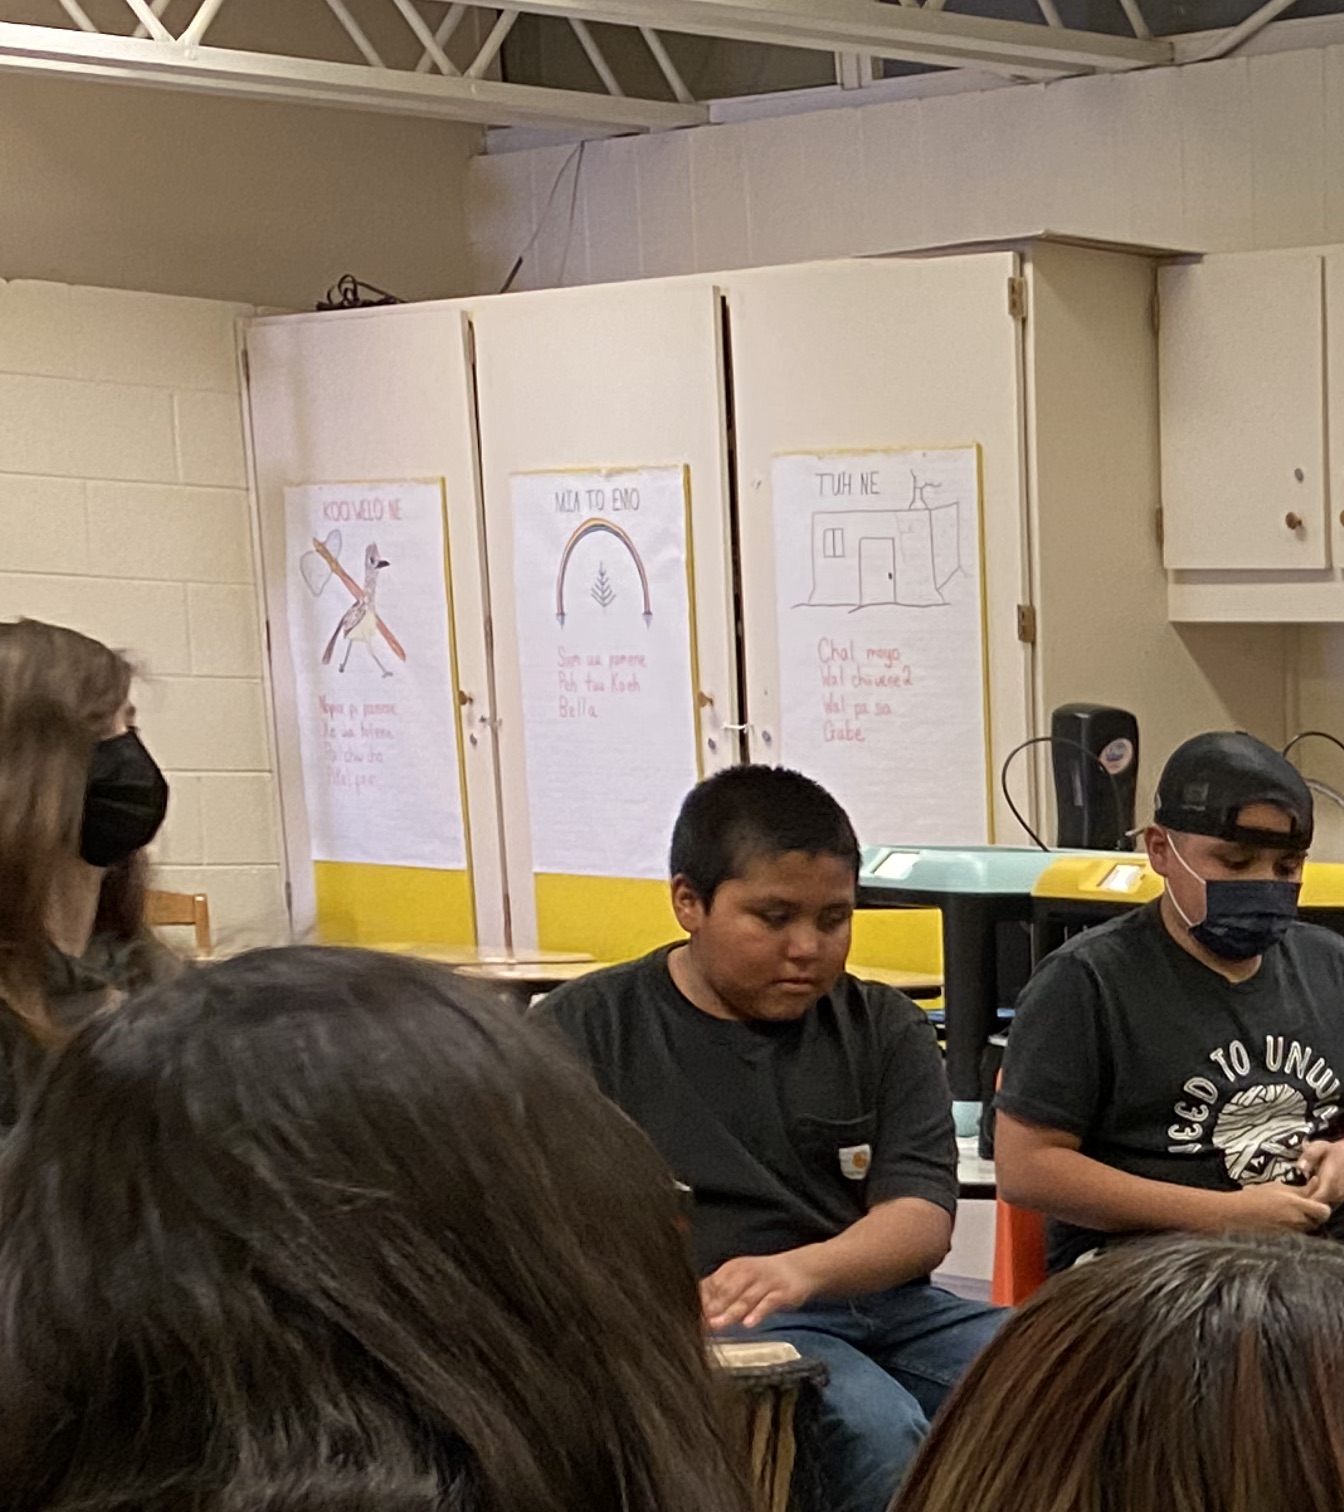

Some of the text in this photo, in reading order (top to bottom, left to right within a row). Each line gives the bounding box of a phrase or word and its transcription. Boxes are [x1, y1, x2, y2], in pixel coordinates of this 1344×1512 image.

[815, 471, 880, 496] TUH NE
[586, 489, 605, 511] TO
[559, 695, 598, 718] Bella
[1210, 1040, 1250, 1082] TO
